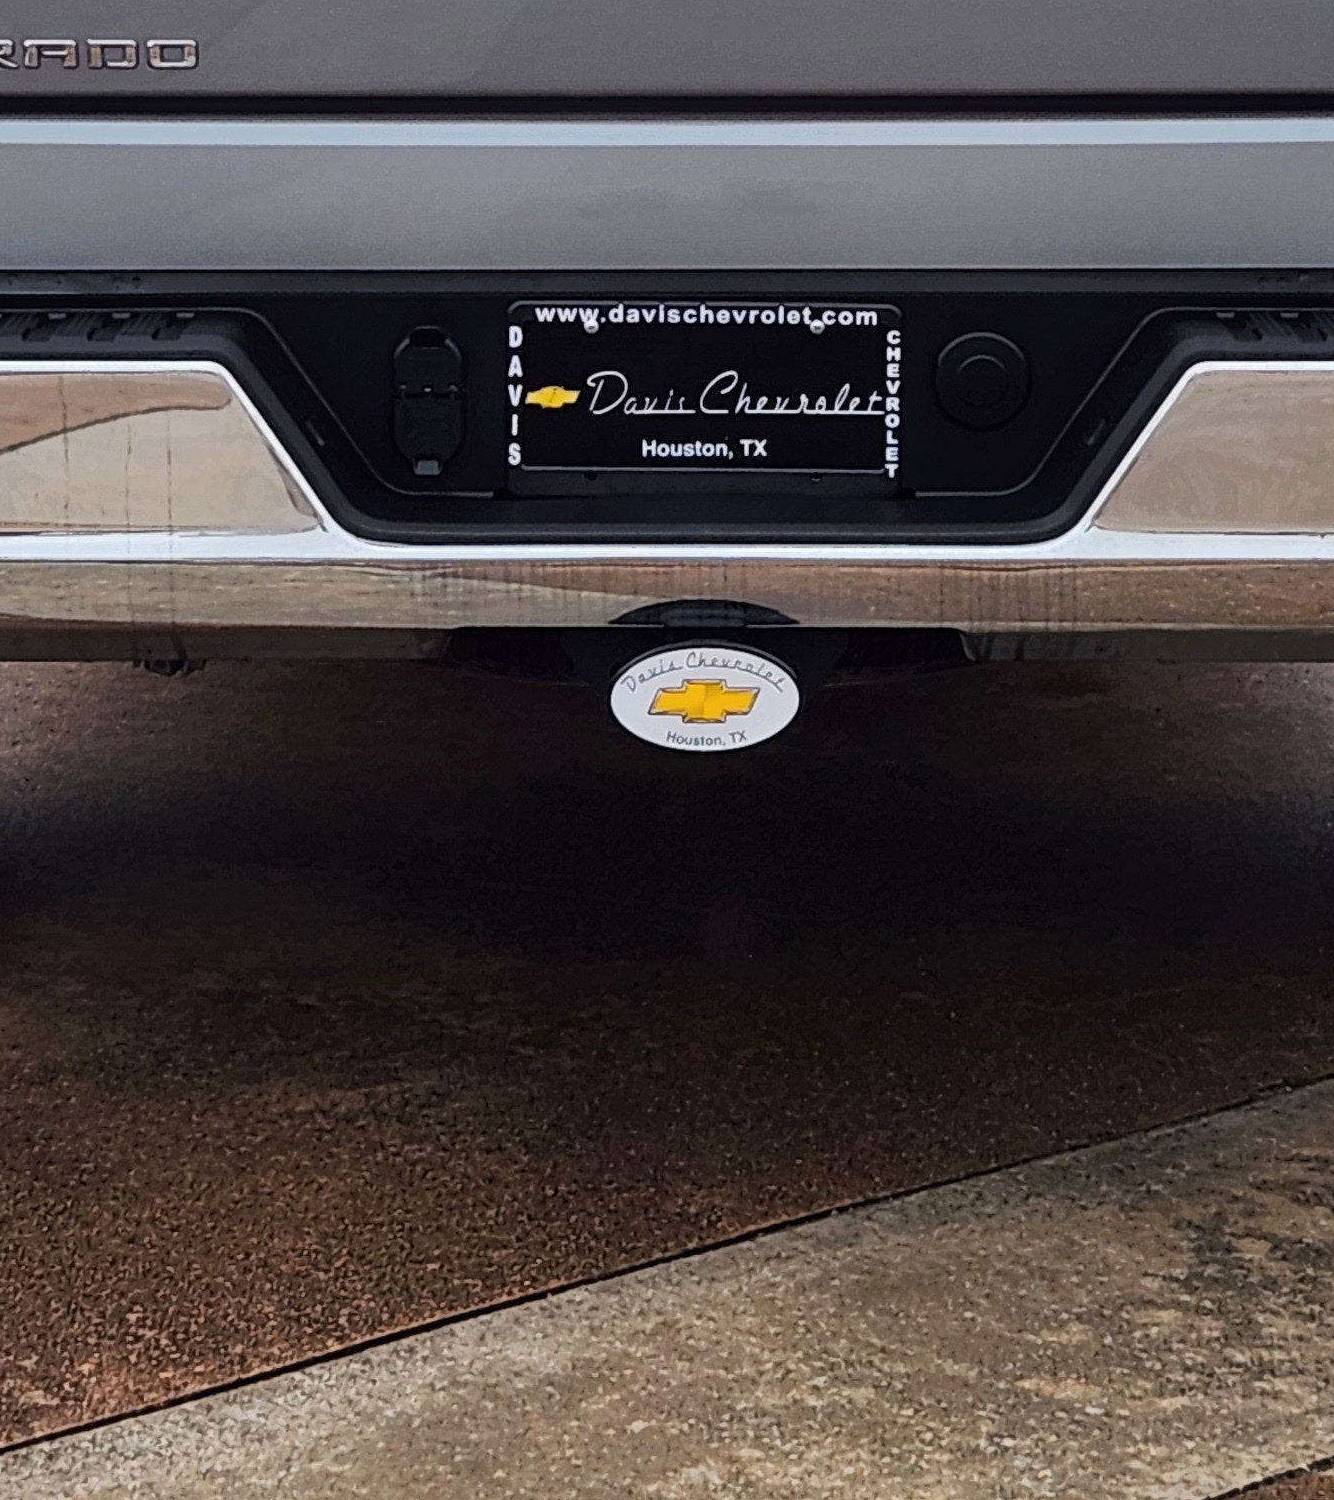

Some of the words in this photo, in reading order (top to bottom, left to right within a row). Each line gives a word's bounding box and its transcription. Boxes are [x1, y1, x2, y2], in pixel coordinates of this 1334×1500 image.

[534, 303, 878, 326] www.davischevroletcom
[507, 325, 524, 466] DAVIS
[586, 370, 696, 415] Davis
[699, 370, 885, 415] Chevrolet
[884, 330, 902, 479] CHEVROLET
[641, 439, 734, 460] Houston,
[739, 439, 768, 457] TX
[620, 659, 684, 692] Davis
[685, 651, 786, 693] Chevrolet
[666, 730, 726, 747] Houston,
[728, 730, 748, 742] TX
